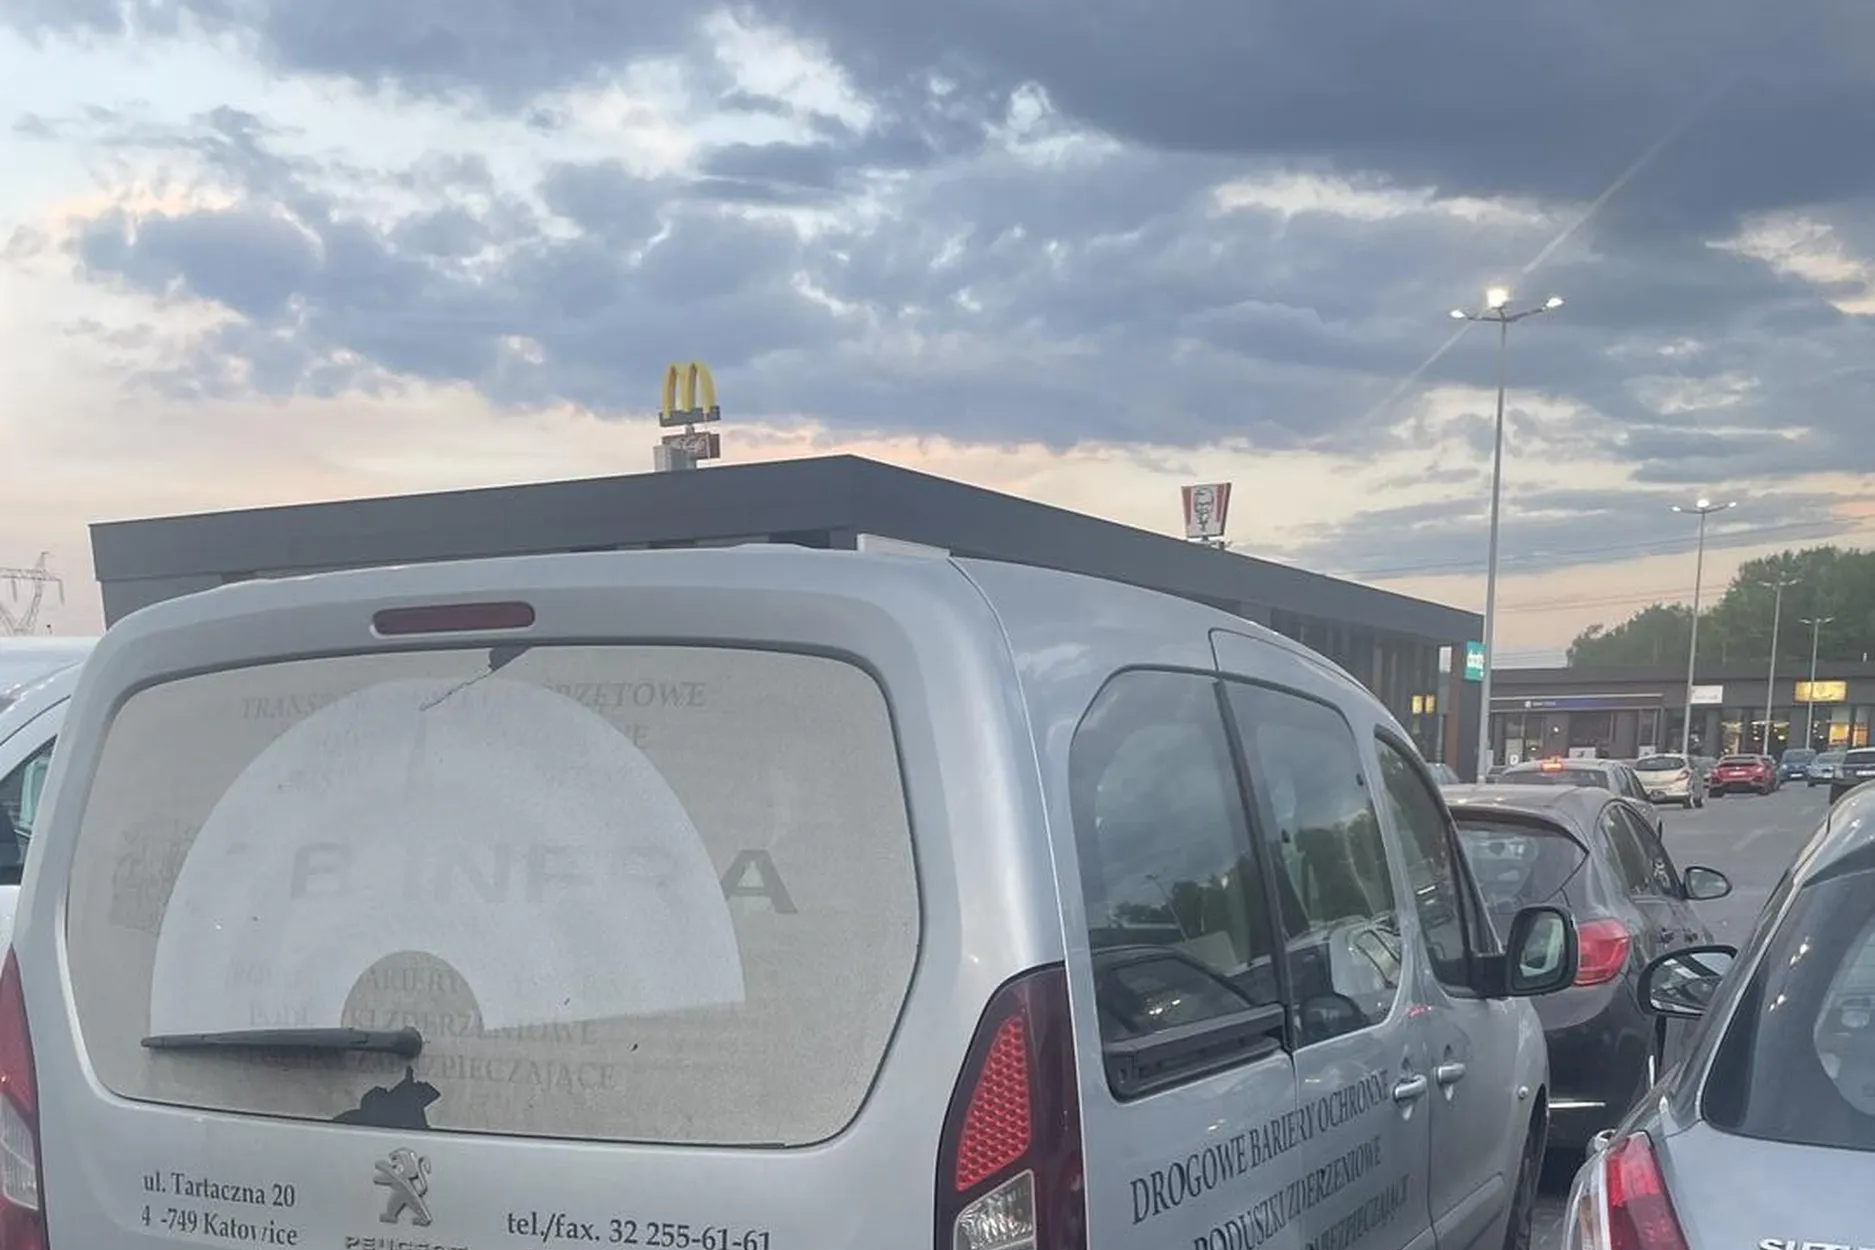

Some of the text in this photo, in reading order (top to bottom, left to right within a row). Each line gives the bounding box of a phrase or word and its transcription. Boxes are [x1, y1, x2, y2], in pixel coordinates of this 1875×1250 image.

[1130, 1134, 1247, 1225] DROGOWE
[1249, 1102, 1315, 1168] BARIERY
[143, 1170, 296, 1208] ul. Tartaczna 20
[141, 1204, 199, 1234] 4-749
[507, 1211, 601, 1244] tel./fax.
[608, 1218, 639, 1245] 32
